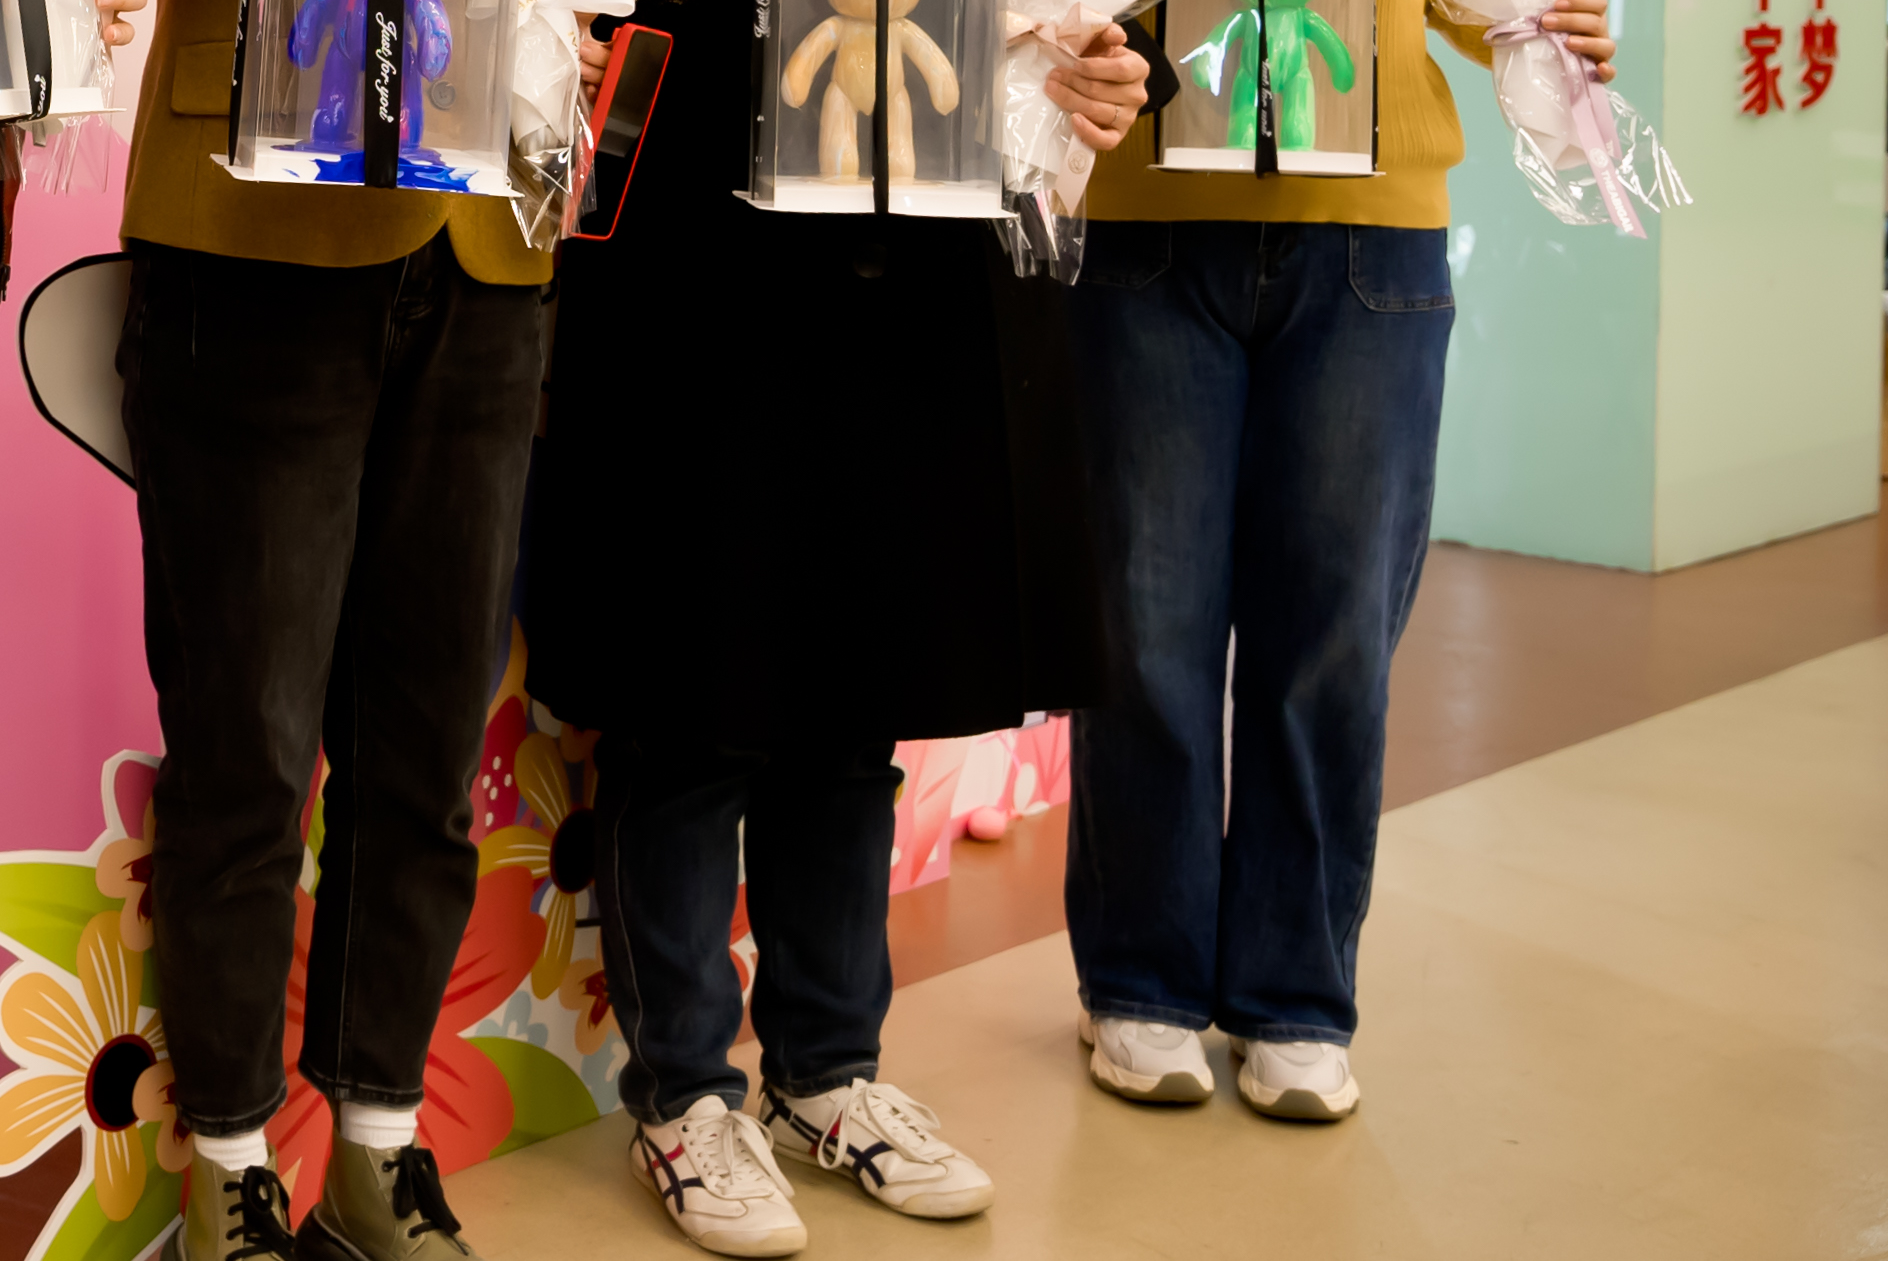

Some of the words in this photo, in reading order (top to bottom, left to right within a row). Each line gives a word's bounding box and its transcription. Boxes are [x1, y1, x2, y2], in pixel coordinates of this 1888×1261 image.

[376, 11, 398, 57] Just
[375, 48, 396, 84] for
[375, 79, 395, 124] you
